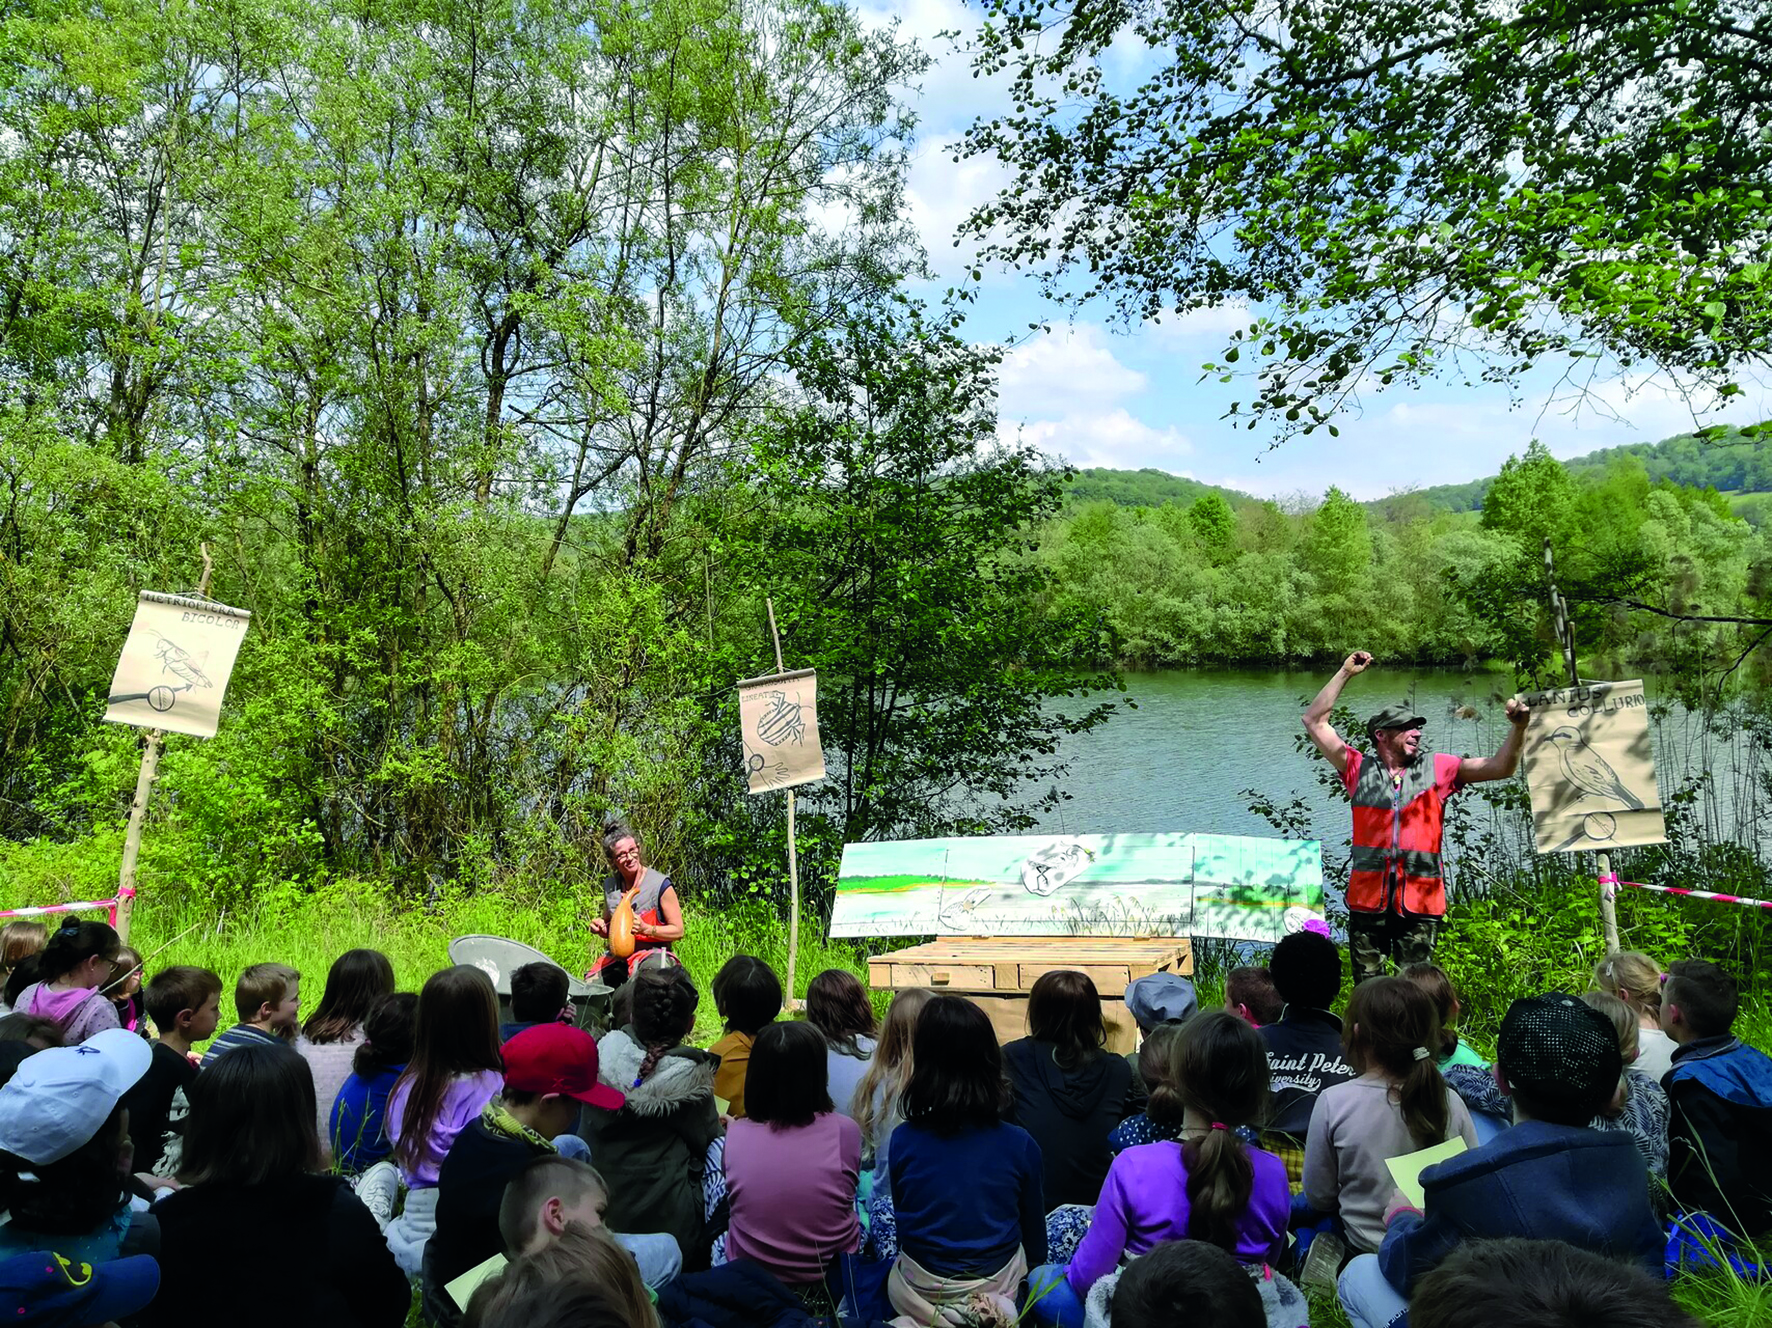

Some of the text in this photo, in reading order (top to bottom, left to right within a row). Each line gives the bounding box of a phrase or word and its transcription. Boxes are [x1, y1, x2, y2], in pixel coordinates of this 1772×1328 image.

[145, 593, 238, 617] METRIOPTERA
[181, 611, 240, 630] BICOLOR
[1526, 686, 1603, 707] LANIUS
[1567, 694, 1645, 718] COLLURIO
[1269, 1072, 1321, 1087] iversity
